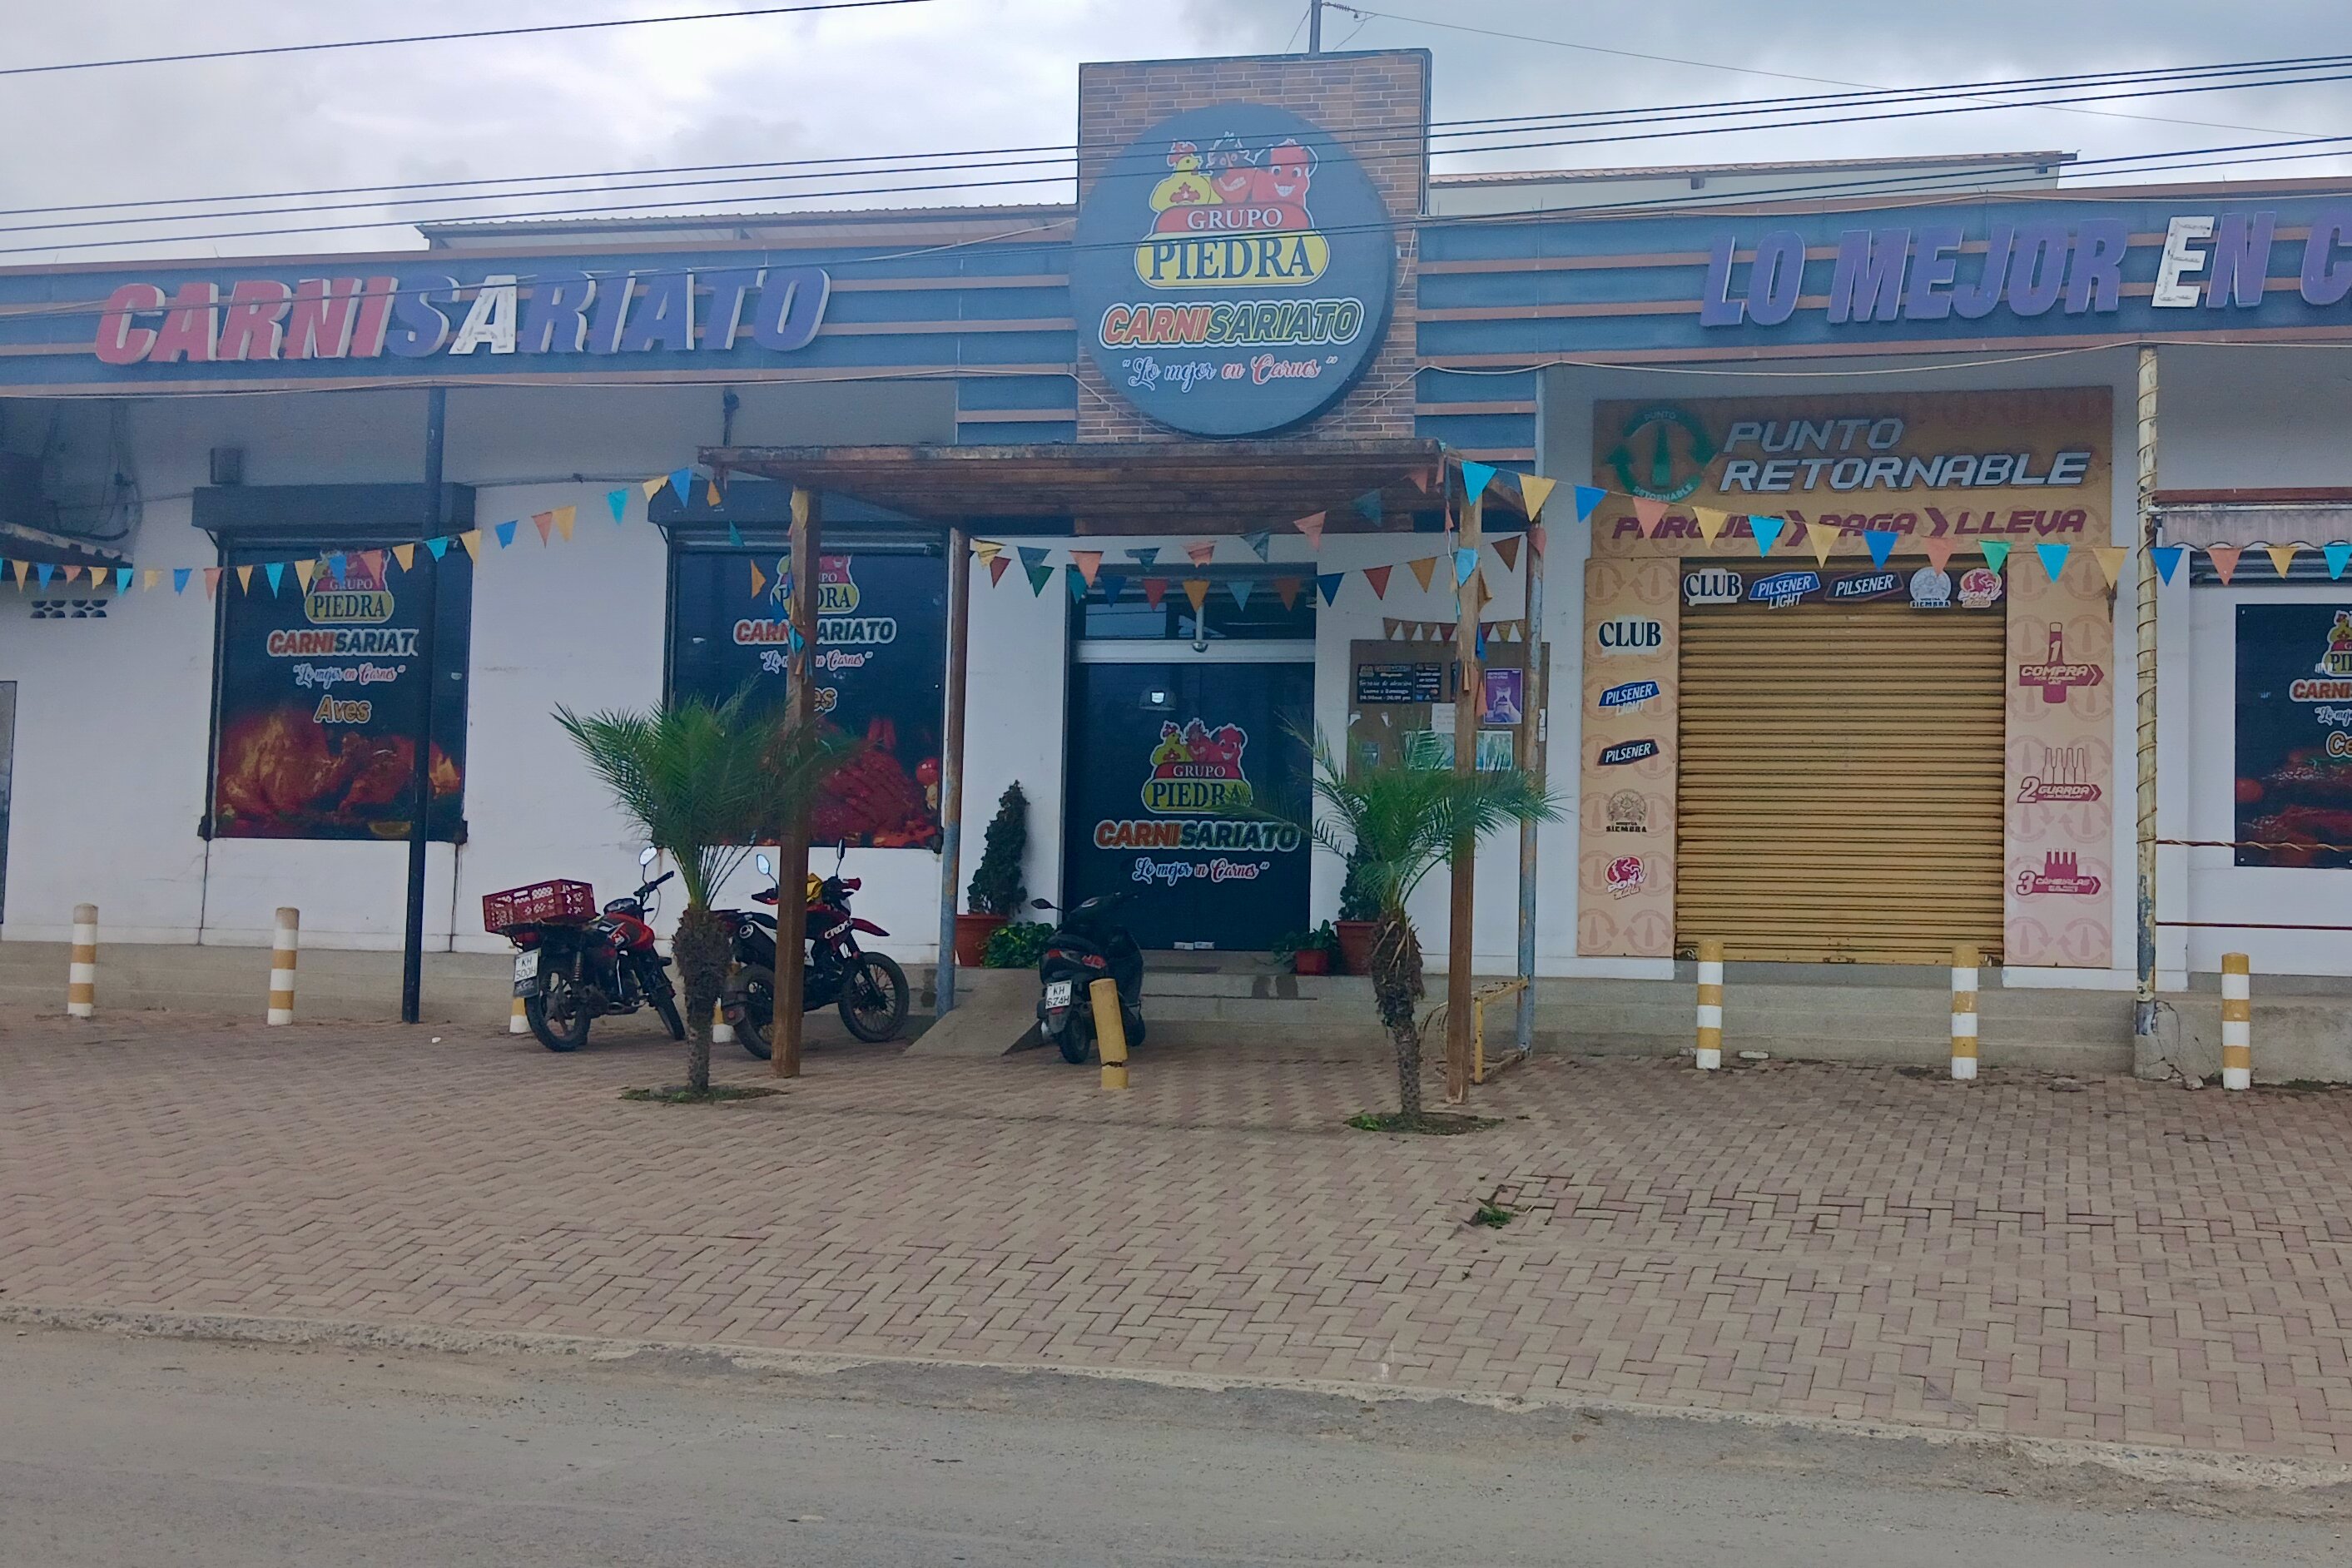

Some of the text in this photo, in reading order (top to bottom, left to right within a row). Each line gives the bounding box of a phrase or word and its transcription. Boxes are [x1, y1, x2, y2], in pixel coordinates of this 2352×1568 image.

[1187, 208, 1283, 230] GRUPO
[1149, 236, 1315, 280] PIEDRA
[1699, 228, 1806, 326] LO
[1827, 218, 2128, 322] MEJOR
[2151, 211, 2276, 309] EN
[96, 267, 831, 365] CARNISARIATO
[1101, 301, 1362, 345] CARNISARIATO
[1644, 410, 1677, 421] PUNTO
[1723, 418, 1905, 453] PUNTO
[1719, 451, 2092, 492] RETORNABLE
[1633, 482, 1695, 502] RETORNABLE
[1954, 509, 2087, 537] LLEVA
[1685, 573, 1742, 598] CLUB
[1757, 574, 1812, 598] PILSENER
[1834, 574, 1894, 598] PILSENER
[312, 594, 386, 618] PIEDRA
[1768, 592, 1804, 610] LIGHT
[267, 630, 419, 655] CARNISARIAT
[1597, 621, 1662, 648] CLUB
[2050, 640, 2062, 662] 1
[2021, 665, 2089, 677] COMPRA
[1605, 683, 1654, 705] PILSENER
[315, 696, 371, 722] Aves
[1605, 742, 1651, 763] PILSENER
[1173, 765, 1226, 778] GRUPO
[2017, 776, 2090, 804] 2 GUARDA
[1094, 821, 1300, 850] CARNISARIATO
[2016, 870, 2037, 896] 3
[521, 956, 533, 967] KH
[1053, 985, 1065, 995] KH
